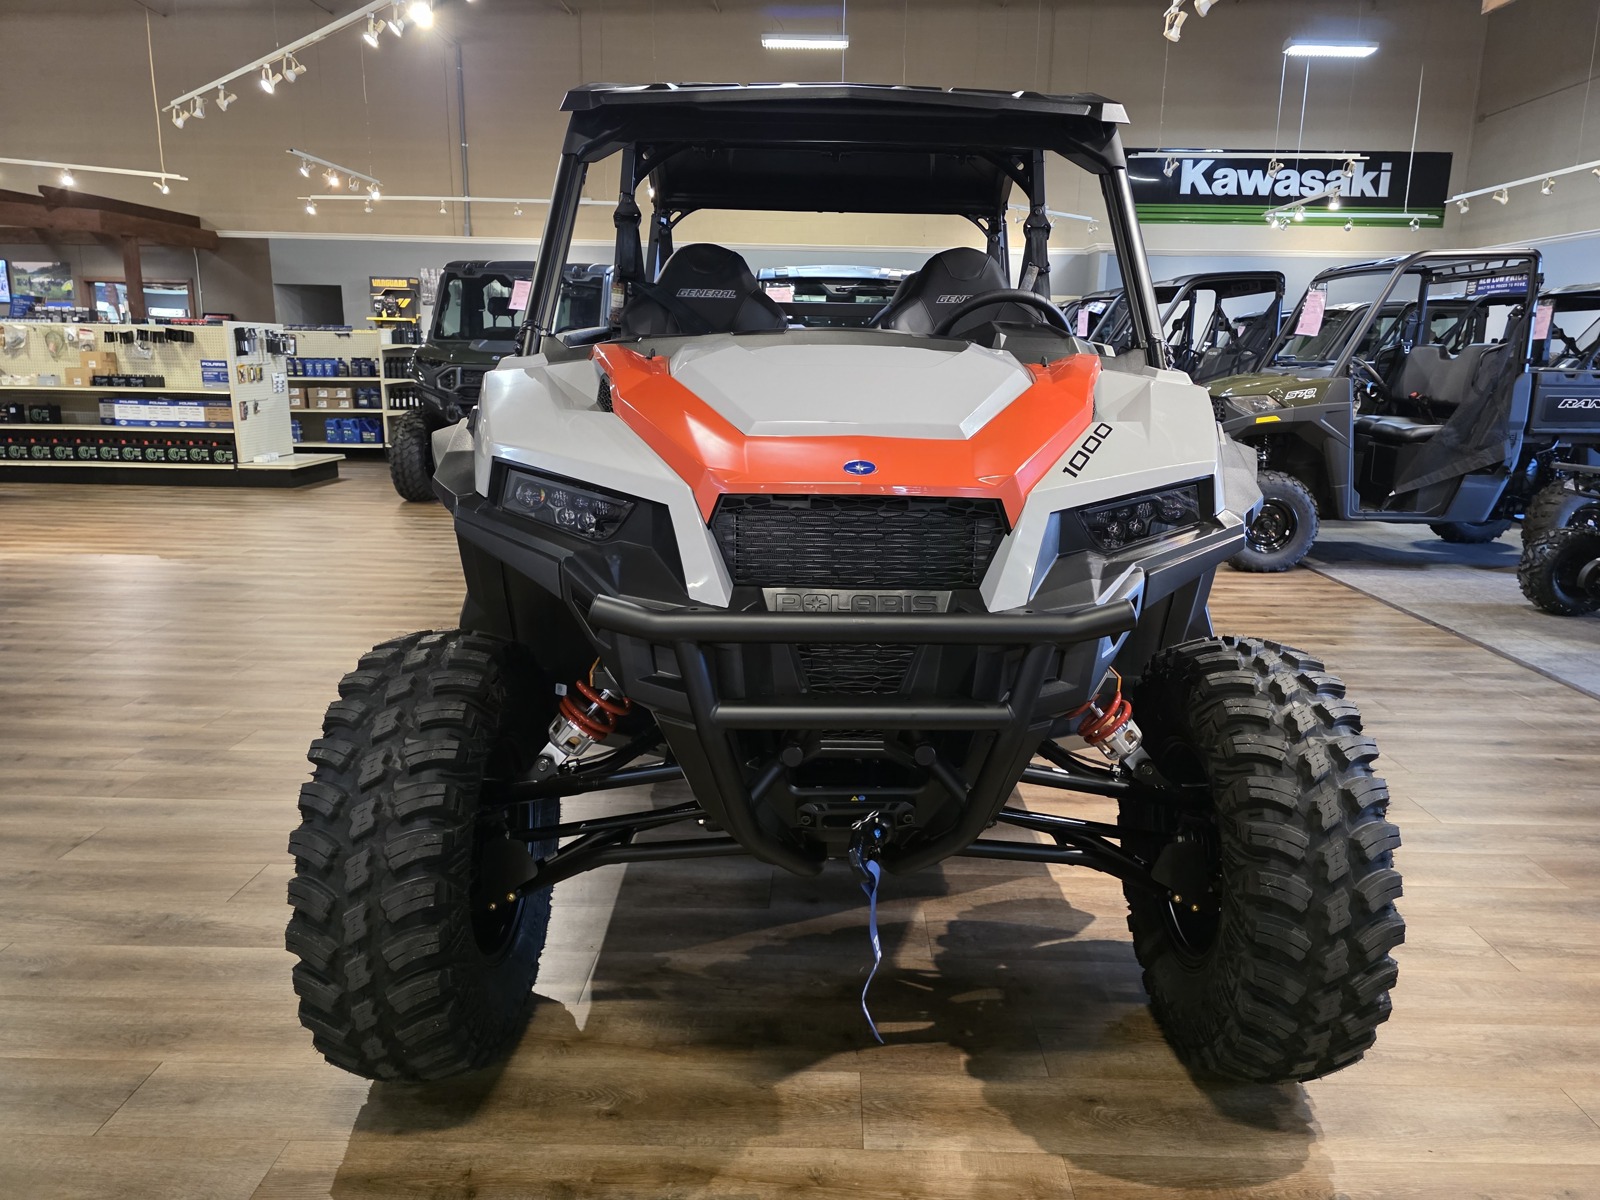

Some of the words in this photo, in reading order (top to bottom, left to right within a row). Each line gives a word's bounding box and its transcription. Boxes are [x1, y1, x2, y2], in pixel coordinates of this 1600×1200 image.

[1179, 159, 1393, 198] Kawasaki
[676, 288, 737, 299] GENERAL
[1063, 423, 1113, 478] 1000
[775, 592, 939, 613] POLARIS
